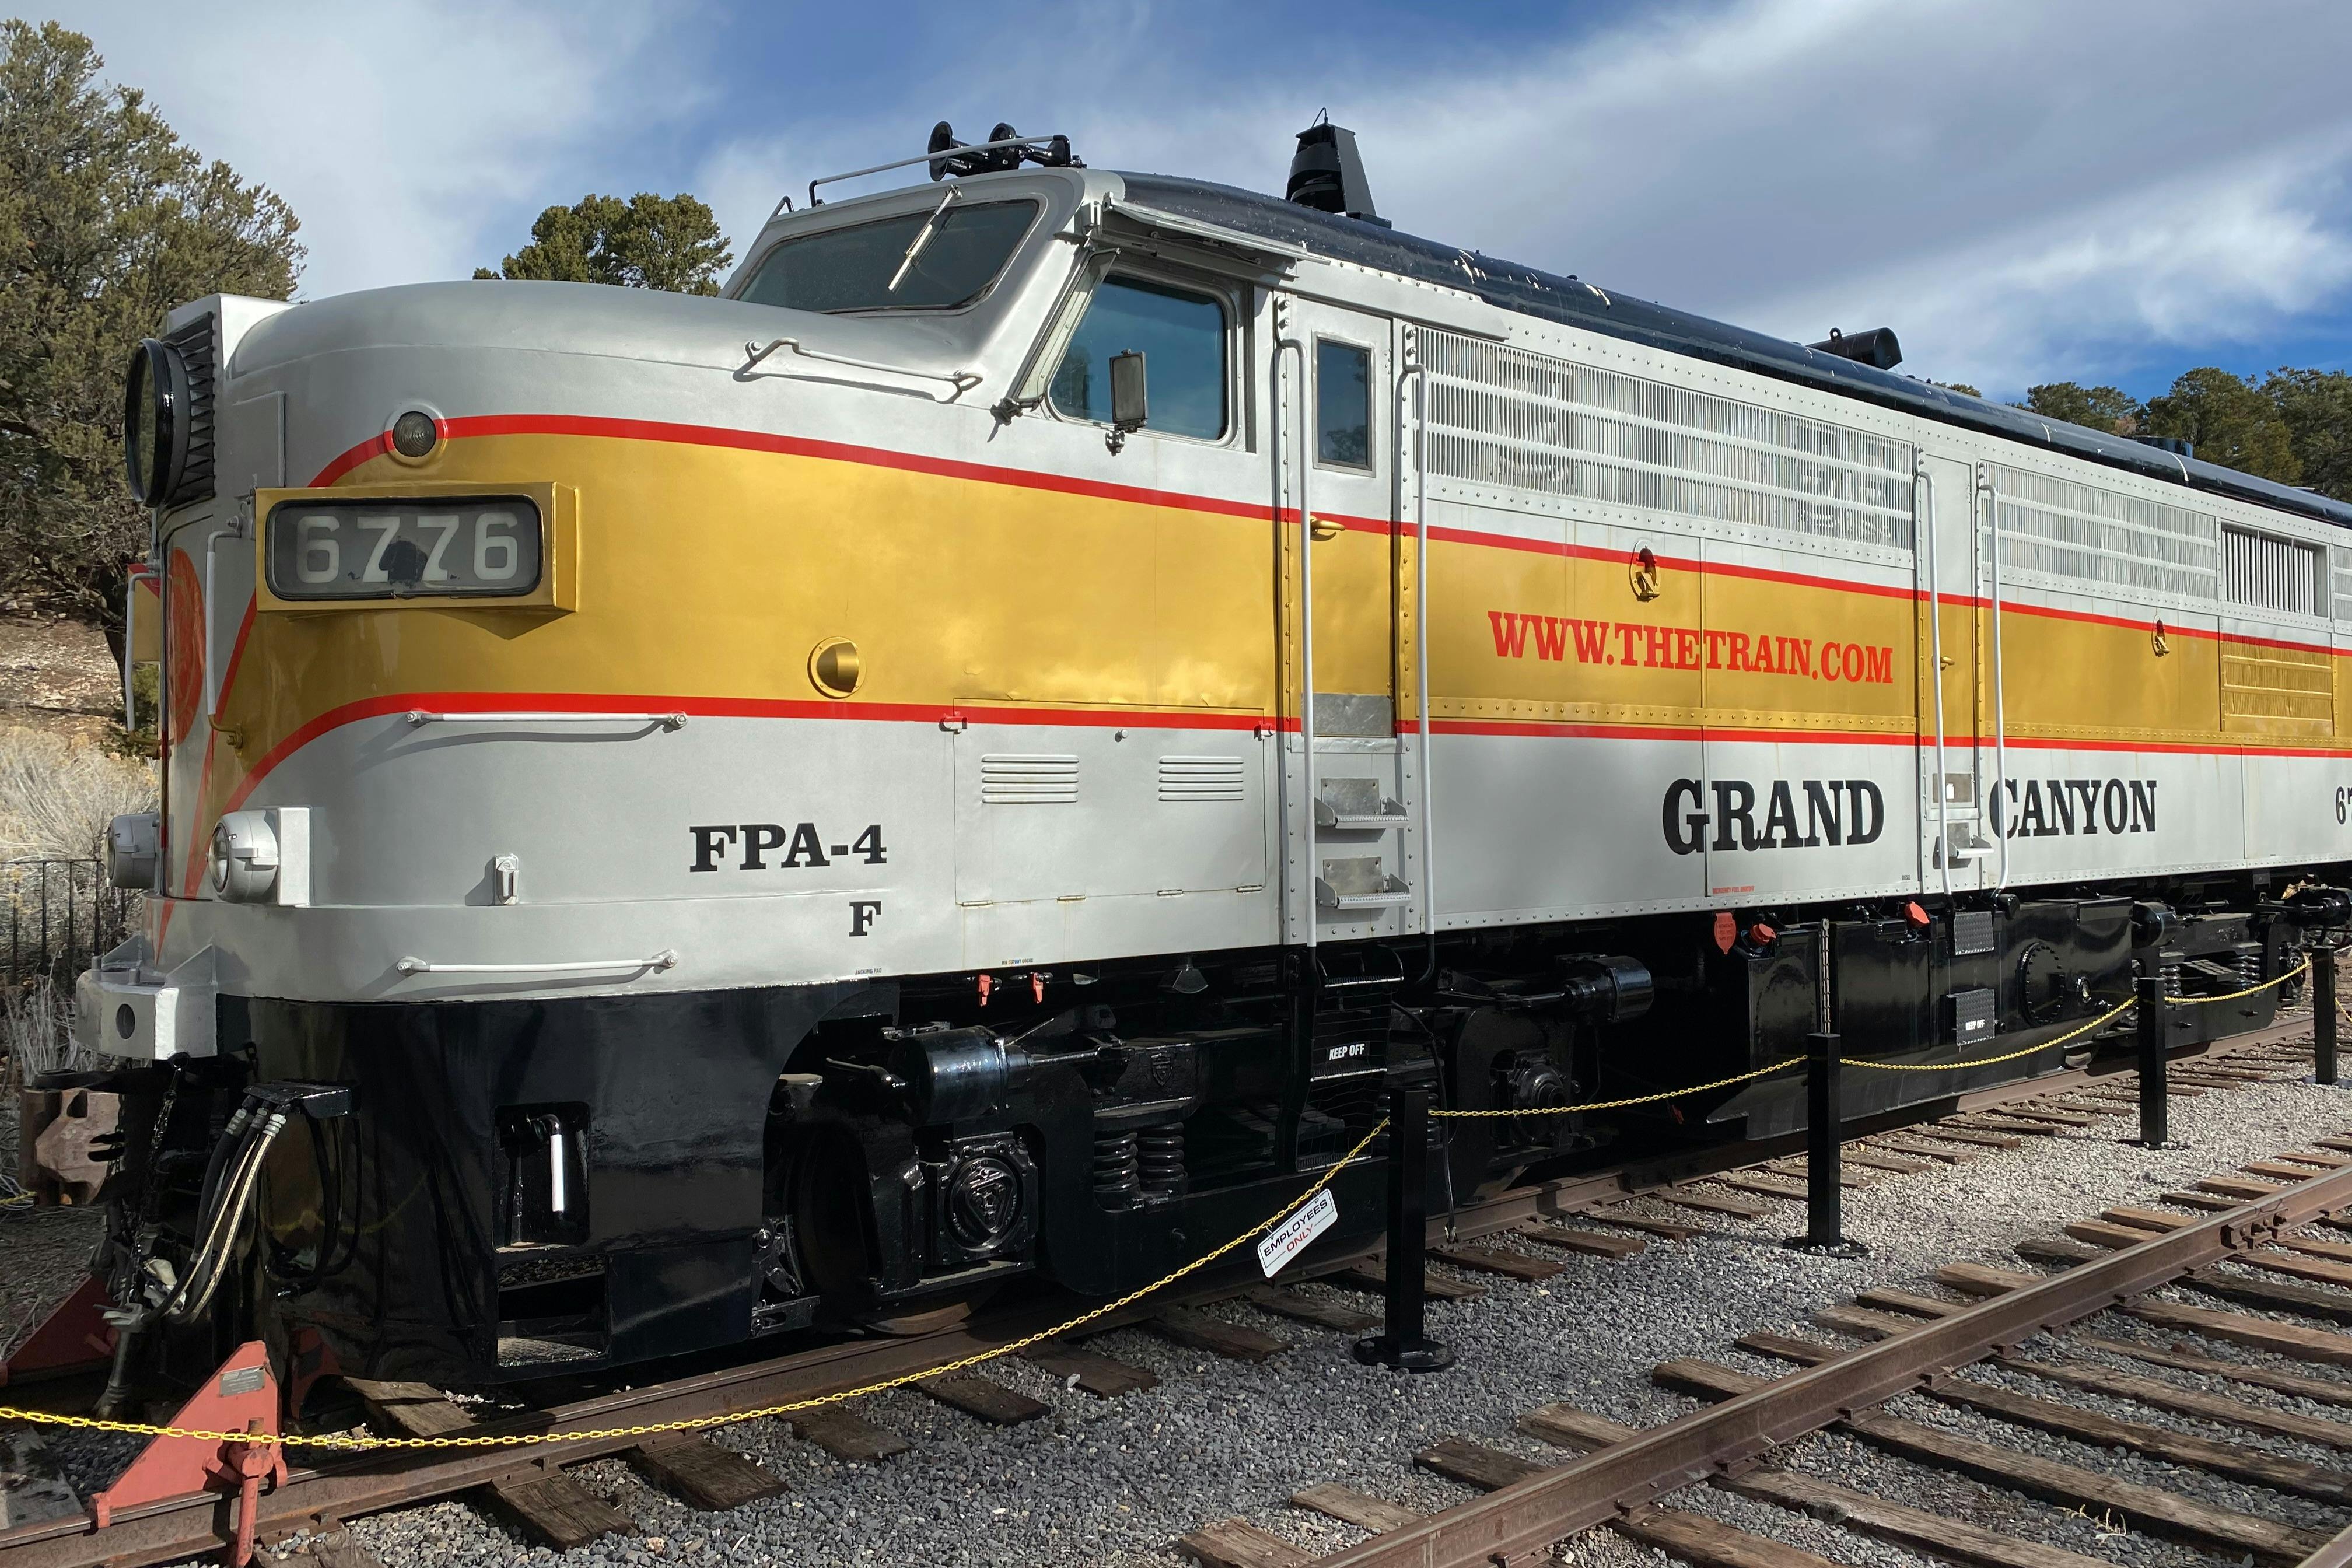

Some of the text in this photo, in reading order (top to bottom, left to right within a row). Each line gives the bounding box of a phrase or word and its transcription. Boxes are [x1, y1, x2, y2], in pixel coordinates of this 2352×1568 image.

[296, 512, 518, 584] 6776
[1488, 611, 1894, 684] WWW.THETRAIN.COM
[1662, 778, 2157, 855] GRAND CANYON
[690, 822, 887, 872] FPA-4
[849, 901, 881, 937] F
[1329, 1044, 1365, 1060] KEEP OFF
[1264, 1199, 1328, 1257] EMPLOYEES
[1286, 1223, 1314, 1252] ONLY
